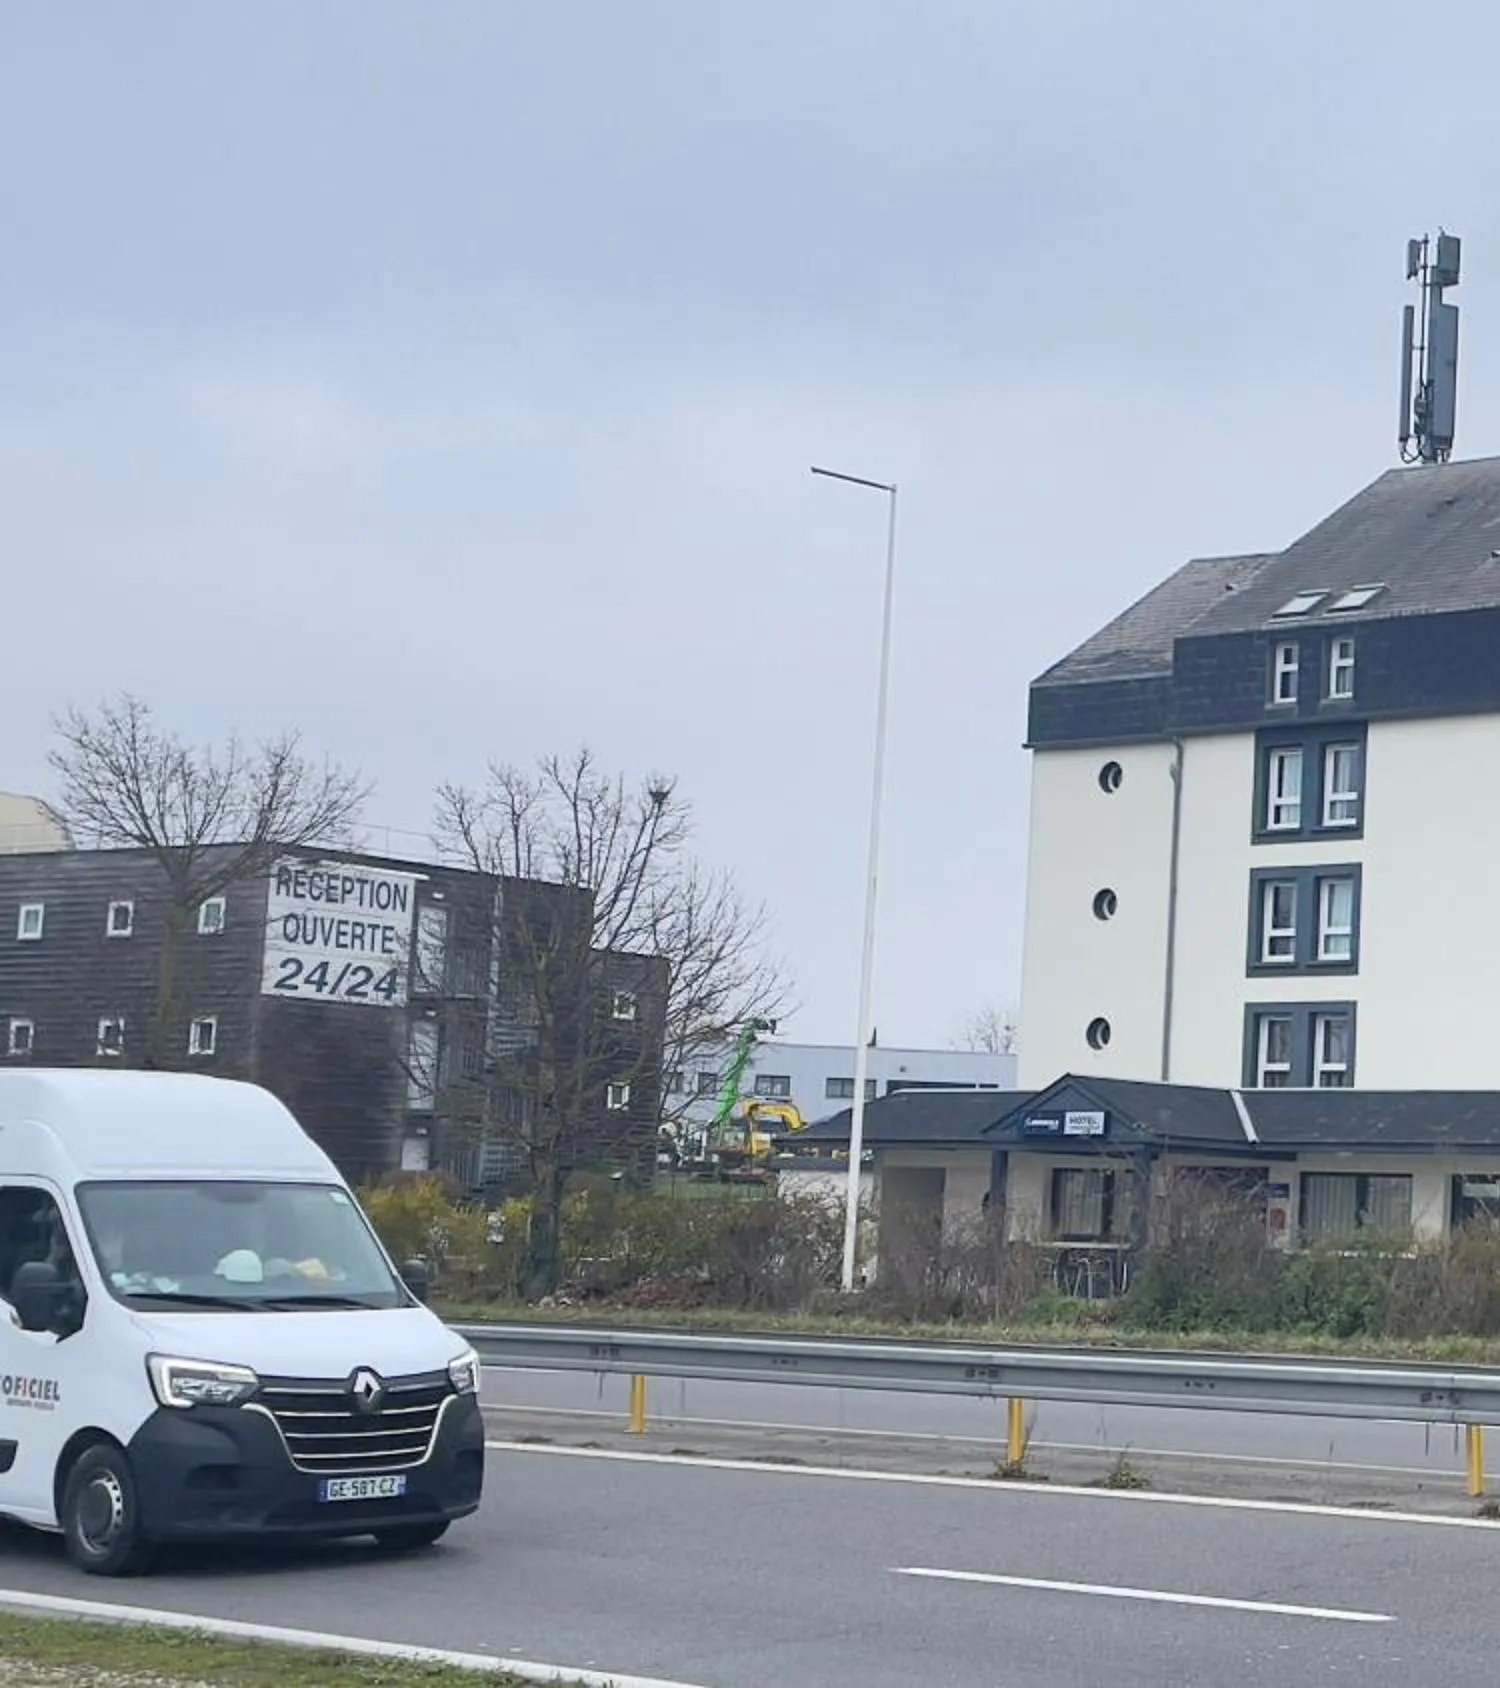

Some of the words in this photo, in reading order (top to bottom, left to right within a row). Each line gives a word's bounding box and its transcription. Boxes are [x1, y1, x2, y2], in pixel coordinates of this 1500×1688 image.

[276, 866, 408, 912] RECEPTION
[283, 913, 396, 953] OUVERTE
[273, 957, 399, 999] 24/24
[0, 1375, 61, 1401] OFICIEL
